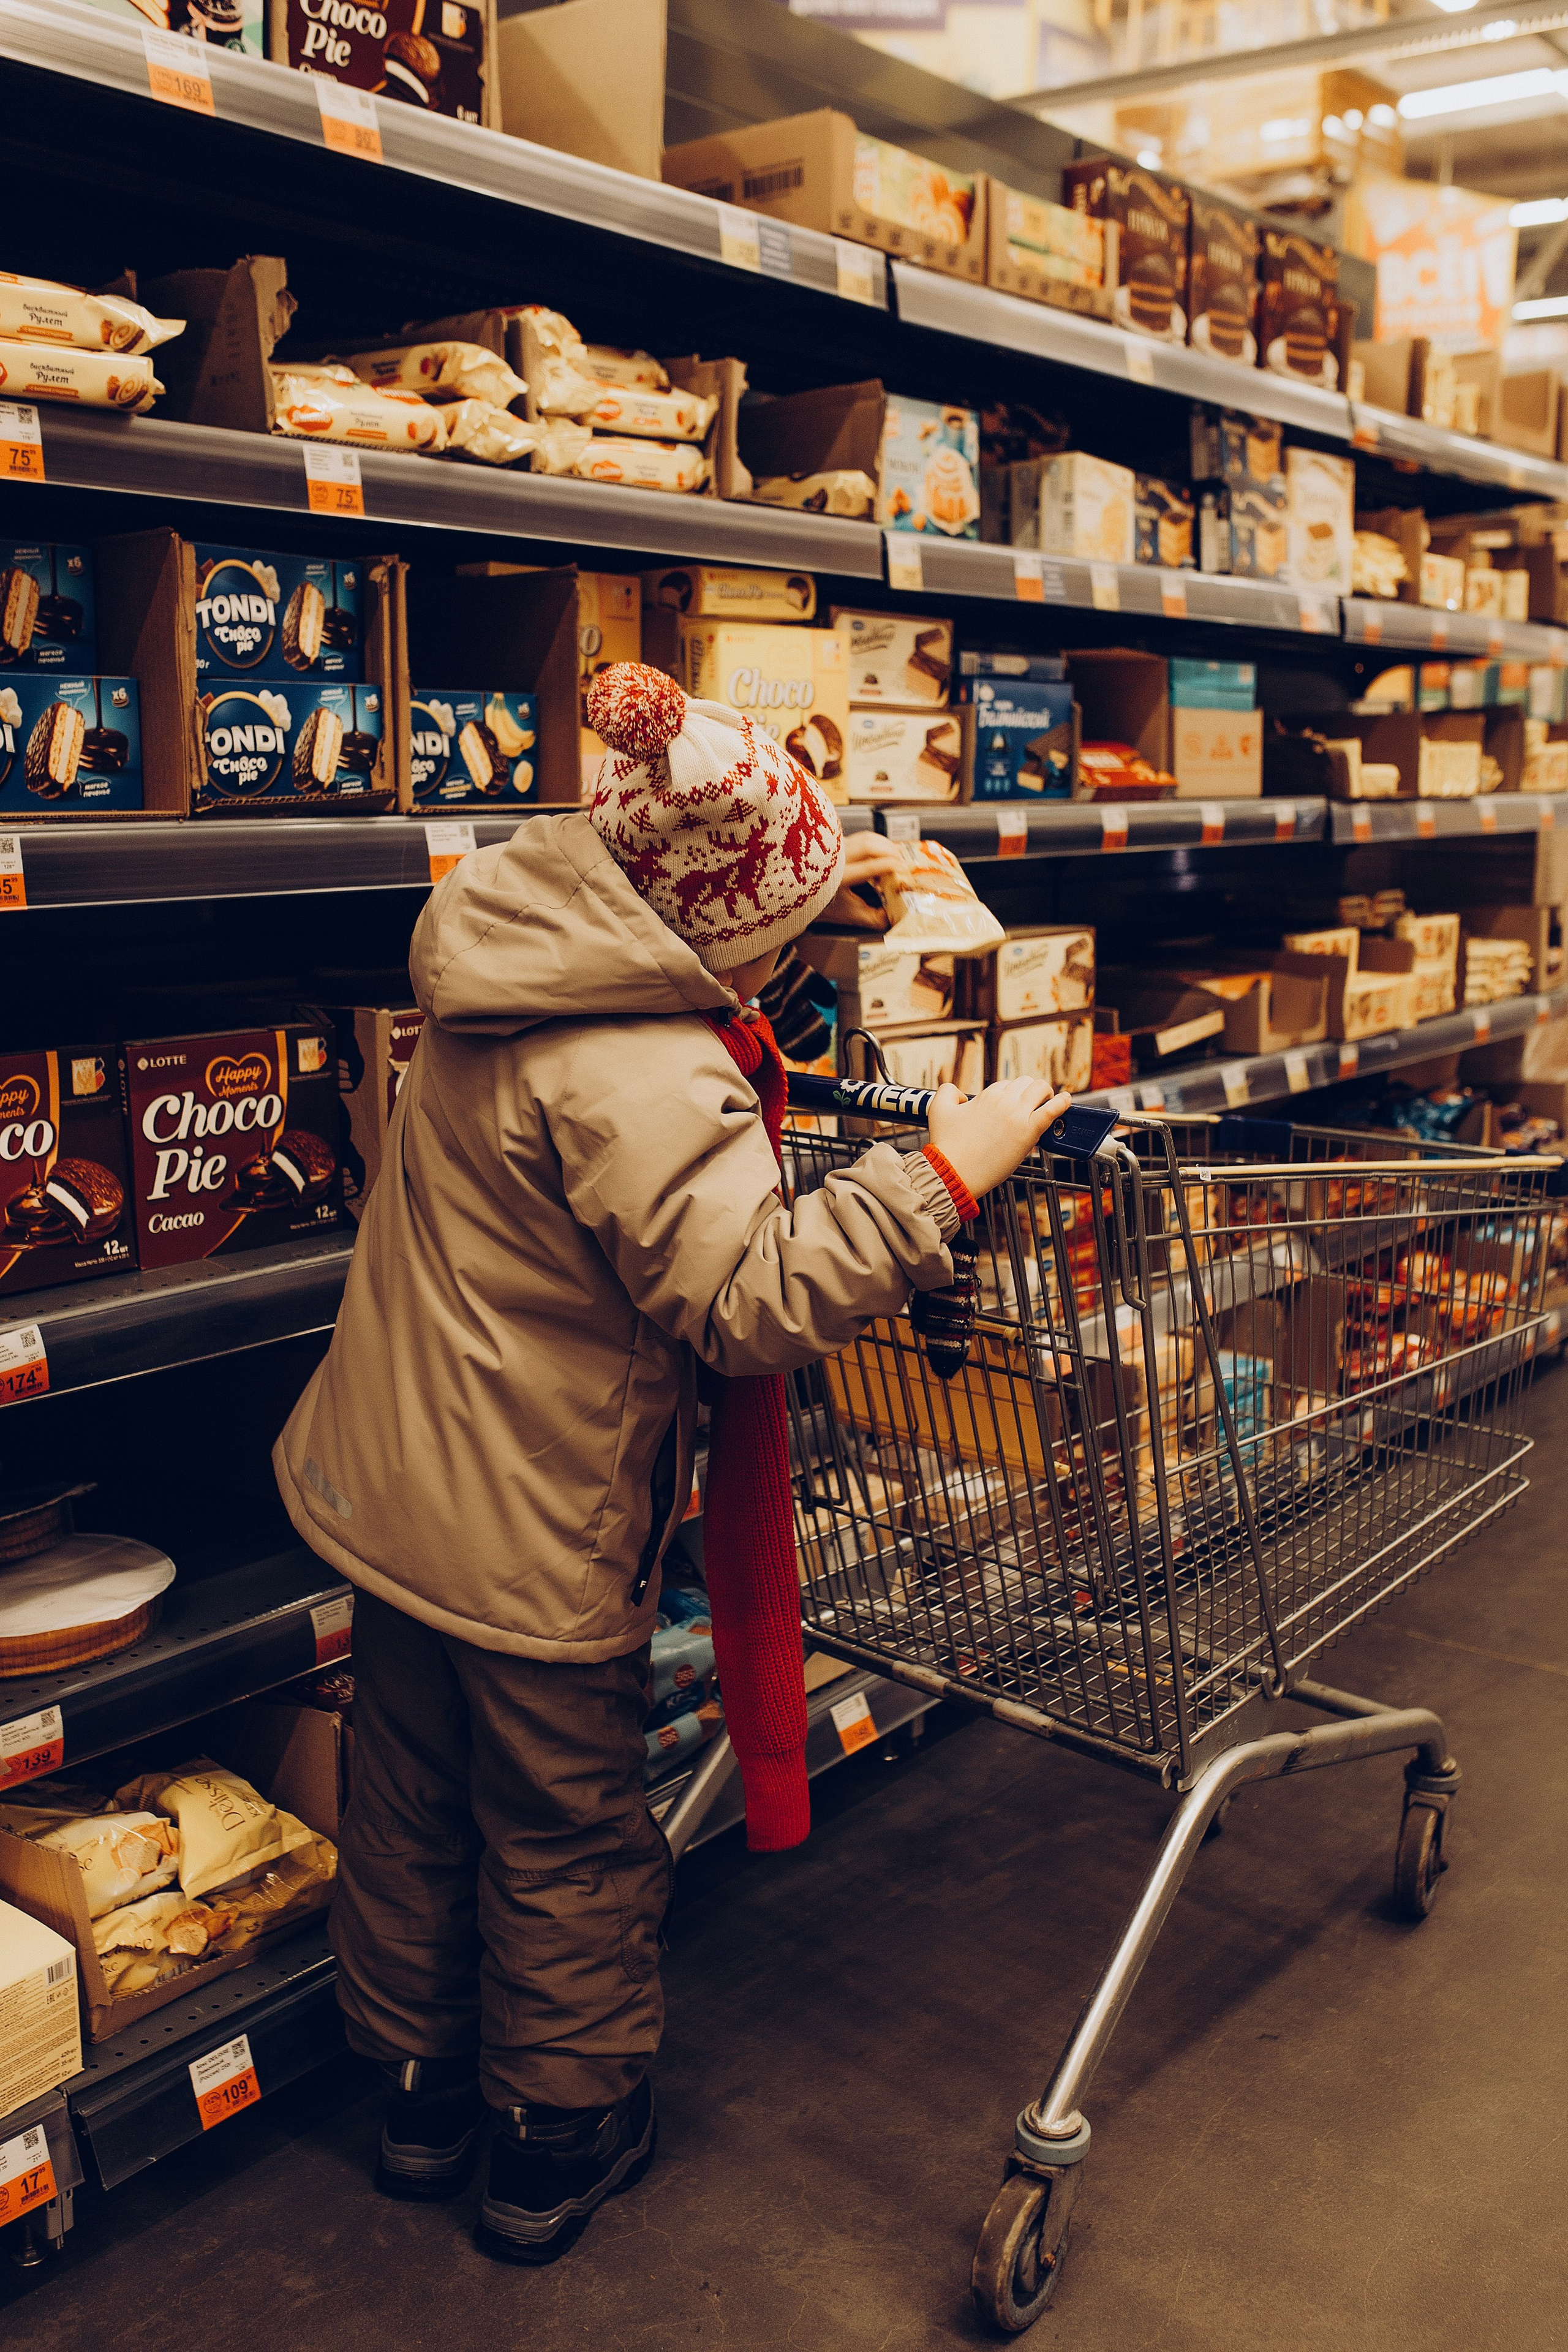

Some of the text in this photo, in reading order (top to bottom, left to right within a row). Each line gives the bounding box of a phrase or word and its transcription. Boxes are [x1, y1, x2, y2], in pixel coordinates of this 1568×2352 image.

[300, 0, 387, 39] Choco
[300, 20, 352, 67] Pie
[175, 77, 201, 96] 169
[29, 312, 63, 326] Рулет
[36, 371, 69, 385] Рулет
[10, 448, 31, 466] 75
[337, 488, 353, 505] 75
[196, 593, 276, 629] TONDI
[728, 667, 816, 709] Choco
[205, 725, 285, 756] ONDI
[410, 731, 451, 758] NDI
[401, 1024, 423, 1037] LOT
[150, 1054, 187, 1068] LOTTE
[215, 1065, 263, 1085] Happy
[218, 1082, 258, 1098] Moments
[856, 1082, 937, 1116] ЛЕНТ
[141, 1091, 282, 1144] Choco
[146, 1145, 227, 1201] Pie
[148, 1210, 205, 1235] Cacao
[6, 1370, 37, 1391] 174
[23, 1749, 51, 1770] 139
[222, 2079, 249, 2103] 109
[21, 2171, 39, 2195] 17
